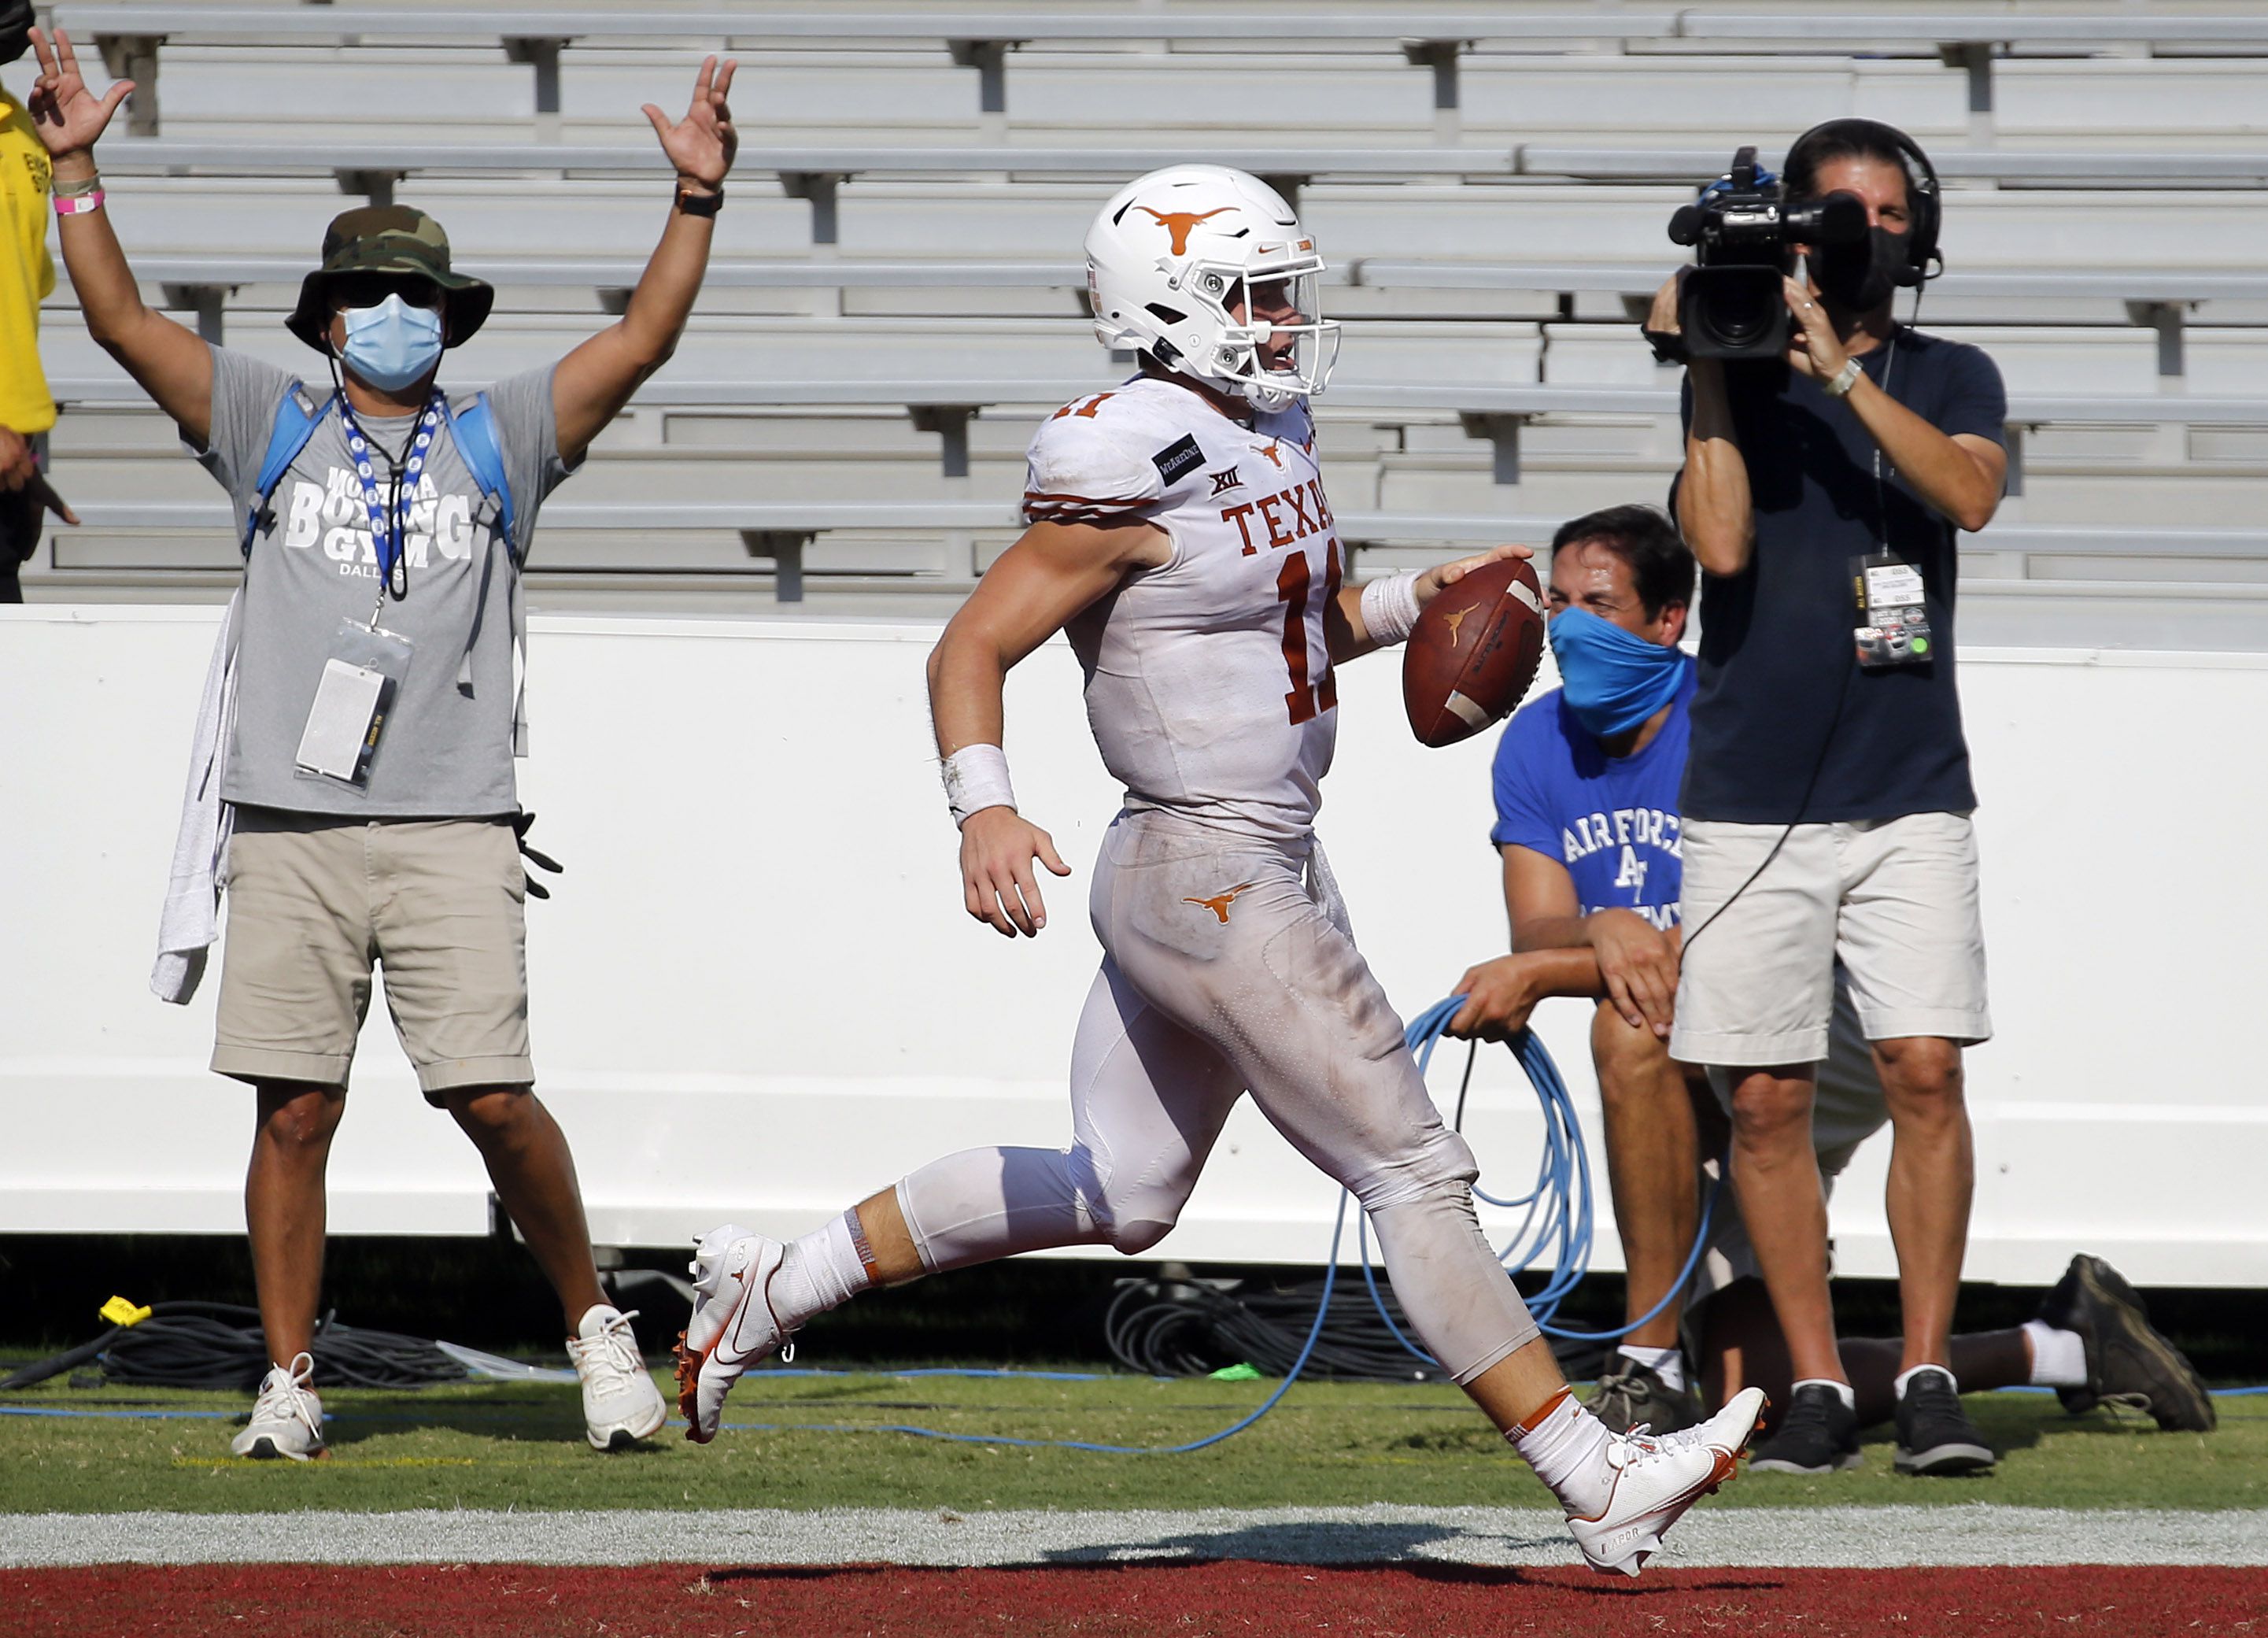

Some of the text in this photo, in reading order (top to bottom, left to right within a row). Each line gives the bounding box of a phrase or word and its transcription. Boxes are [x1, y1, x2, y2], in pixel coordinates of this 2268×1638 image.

[1051, 393, 1117, 420] 11
[286, 481, 472, 560] BOXNG
[1221, 479, 1334, 556] TEXA
[339, 564, 404, 580] DALLS
[1276, 536, 1343, 726] 11
[1563, 812, 1615, 863] AIR
